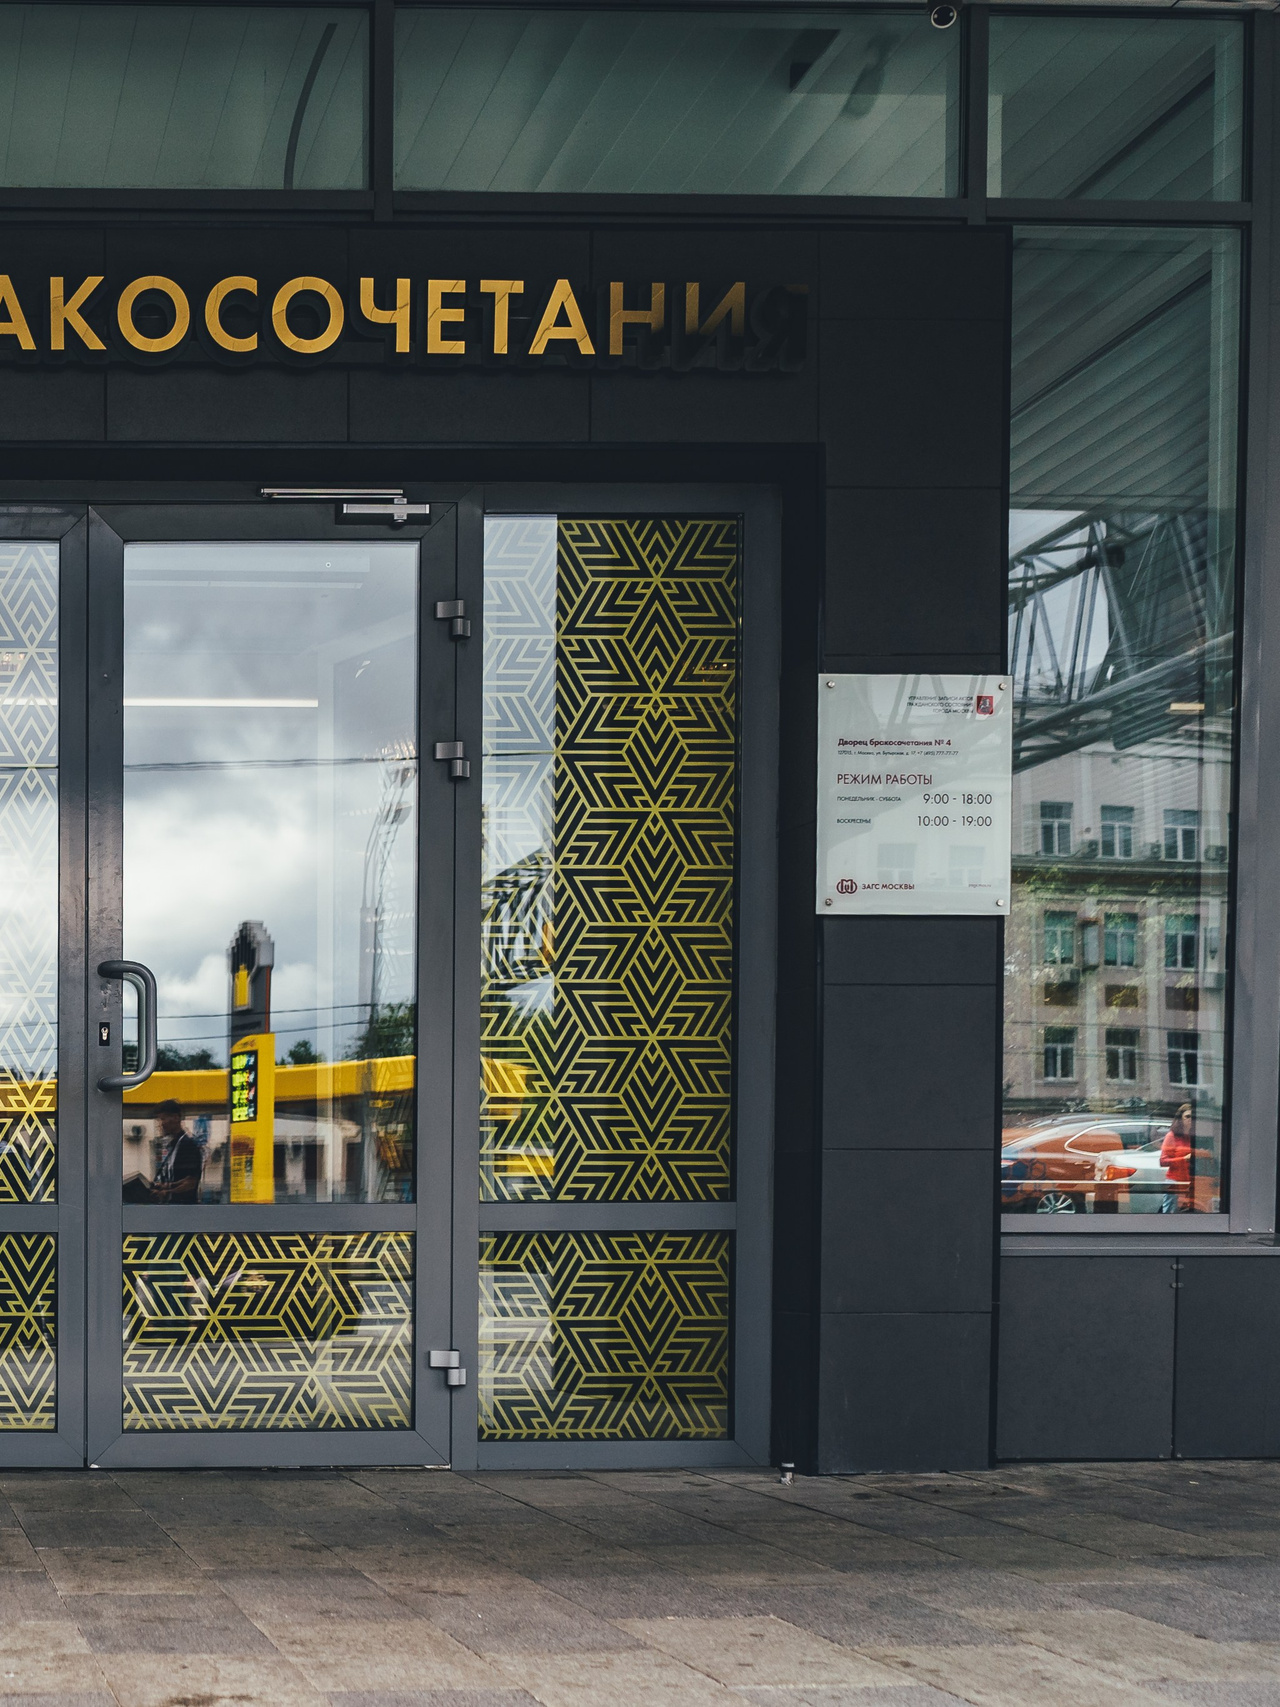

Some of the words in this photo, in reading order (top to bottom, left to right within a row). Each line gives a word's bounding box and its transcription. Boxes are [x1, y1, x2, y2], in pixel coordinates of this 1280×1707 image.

[838, 738, 868, 747] Дворец
[869, 738, 932, 748] бракосочетания
[946, 739, 952, 747] 4
[837, 773, 881, 785] РЕЖИМ
[885, 773, 933, 785] РАБОТЫ
[923, 793, 949, 805] 9:00
[961, 793, 993, 805] 18:00
[917, 815, 949, 827] 10:00
[961, 815, 993, 827] 19:00
